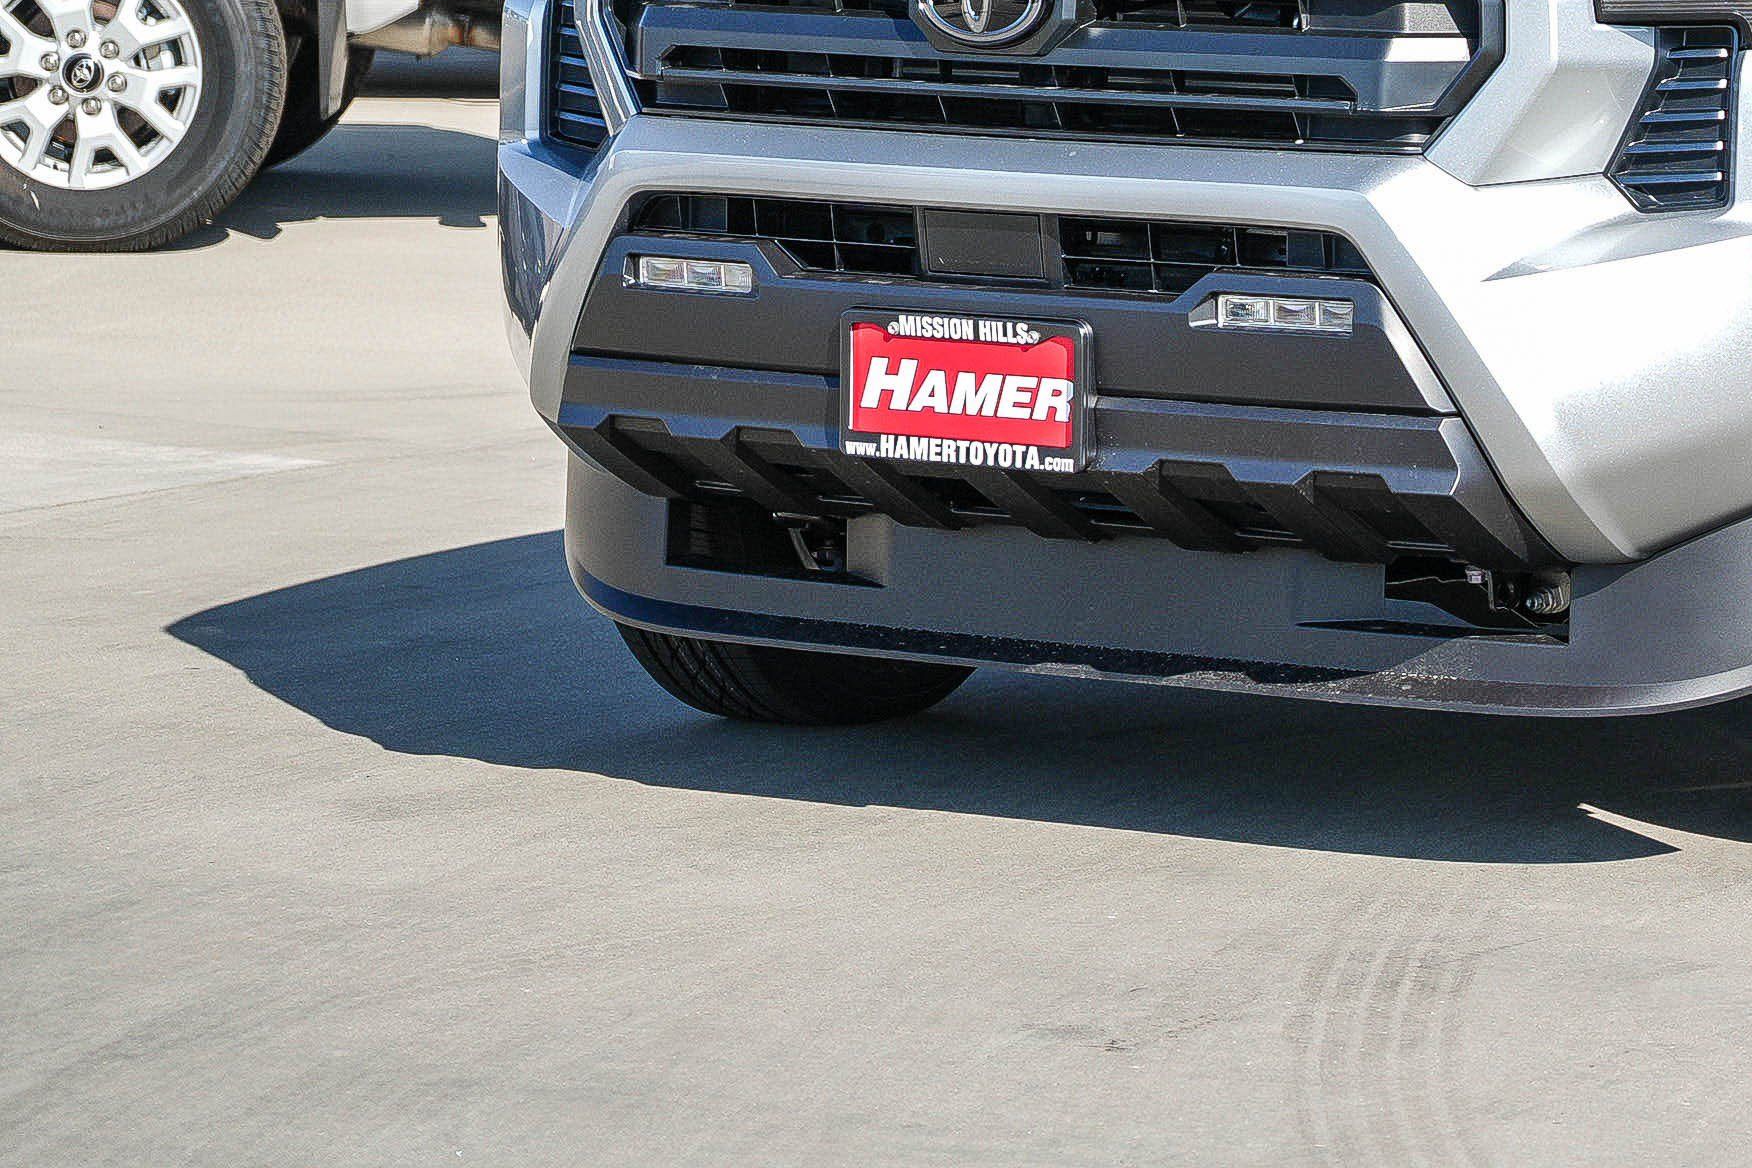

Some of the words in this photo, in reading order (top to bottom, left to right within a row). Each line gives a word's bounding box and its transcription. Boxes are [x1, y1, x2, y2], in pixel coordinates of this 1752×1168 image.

[898, 314, 975, 341] MISSION
[978, 319, 1030, 344] HILLS
[860, 355, 1074, 423] HAMER
[845, 434, 1075, 474] www.HAMERTOYOTA.com
